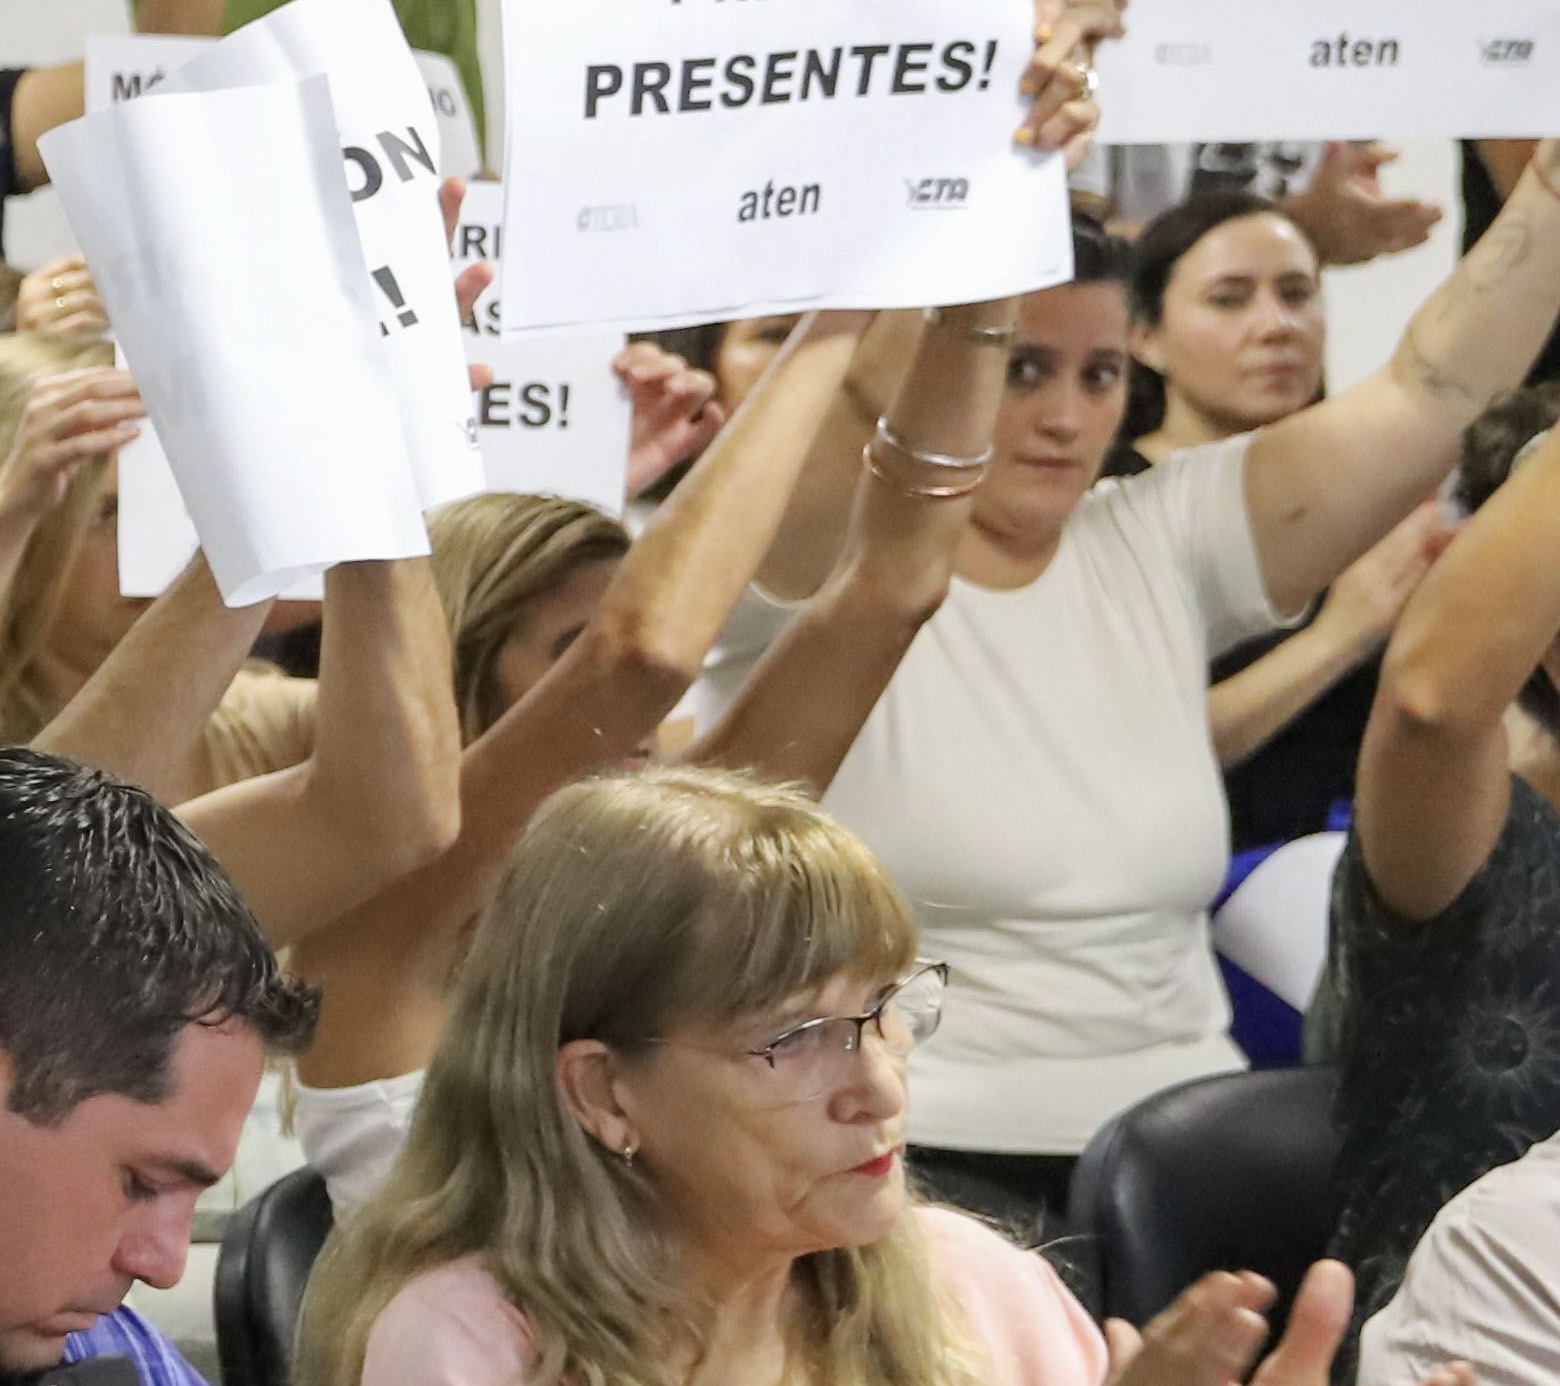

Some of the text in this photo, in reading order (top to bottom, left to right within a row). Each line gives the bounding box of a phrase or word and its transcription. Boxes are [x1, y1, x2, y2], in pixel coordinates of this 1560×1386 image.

[1309, 33, 1399, 67] aten
[584, 40, 998, 119] PRESENTES!
[737, 180, 821, 223] aten
